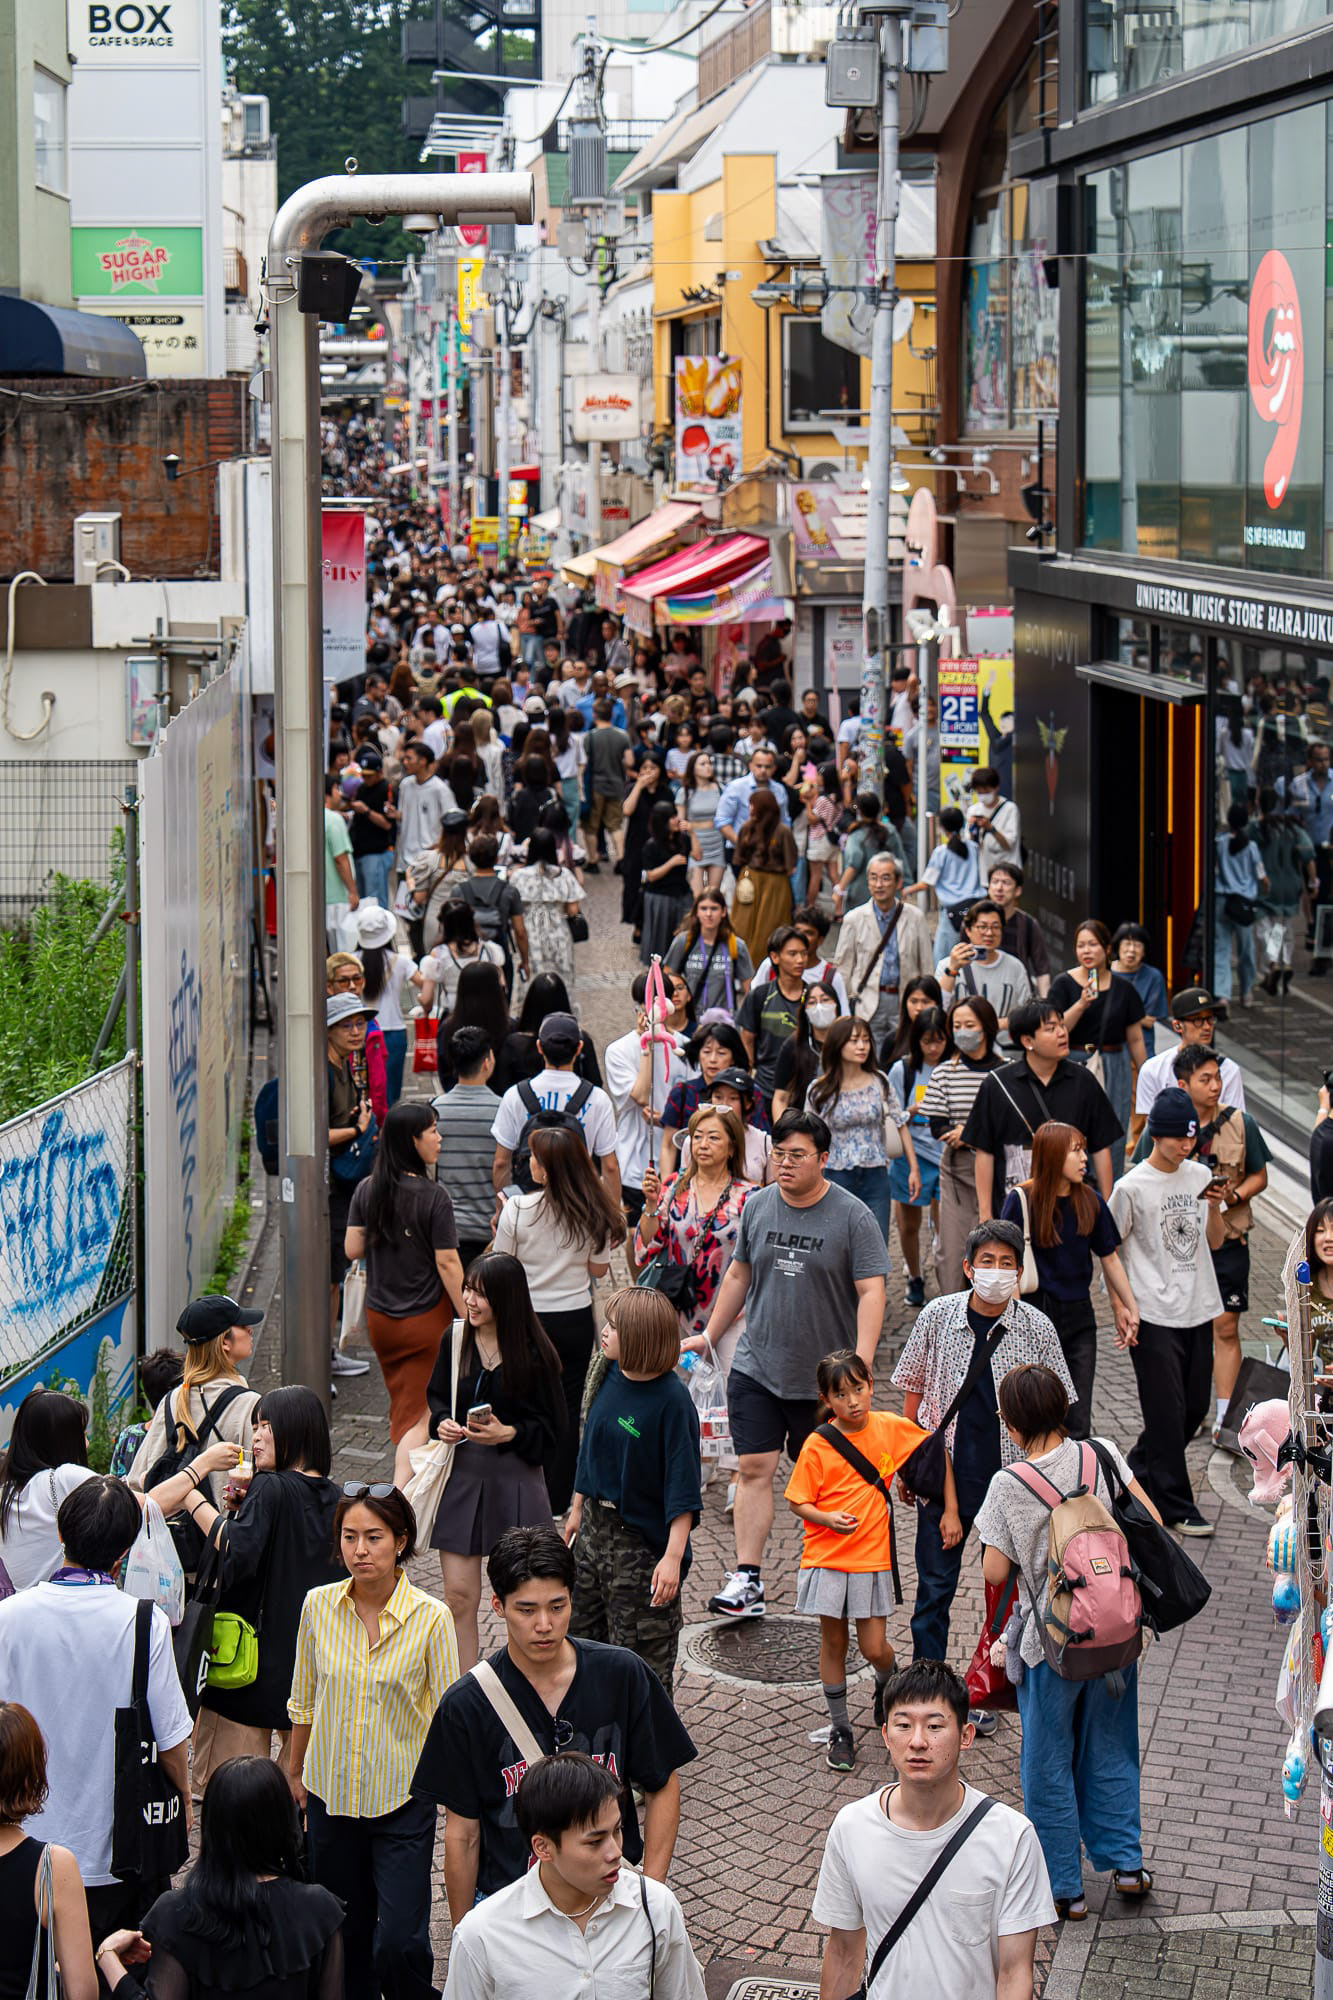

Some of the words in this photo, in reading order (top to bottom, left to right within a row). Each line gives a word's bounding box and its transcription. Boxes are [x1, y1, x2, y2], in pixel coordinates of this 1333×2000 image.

[89, 4, 173, 34] BOX
[102, 248, 168, 270] SUGAR
[113, 265, 162, 283] HIGH!
[1136, 583, 1190, 617] UNIVERSAL
[1192, 593, 1226, 624] MUSIC
[1228, 600, 1265, 631] STORE
[1268, 605, 1333, 644] HARAJUKU
[1024, 622, 1049, 659] BON
[1050, 628, 1080, 671] JOVI
[943, 696, 975, 721] 2F
[1186, 1120, 1197, 1138] S
[765, 1230, 825, 1252] BLACK
